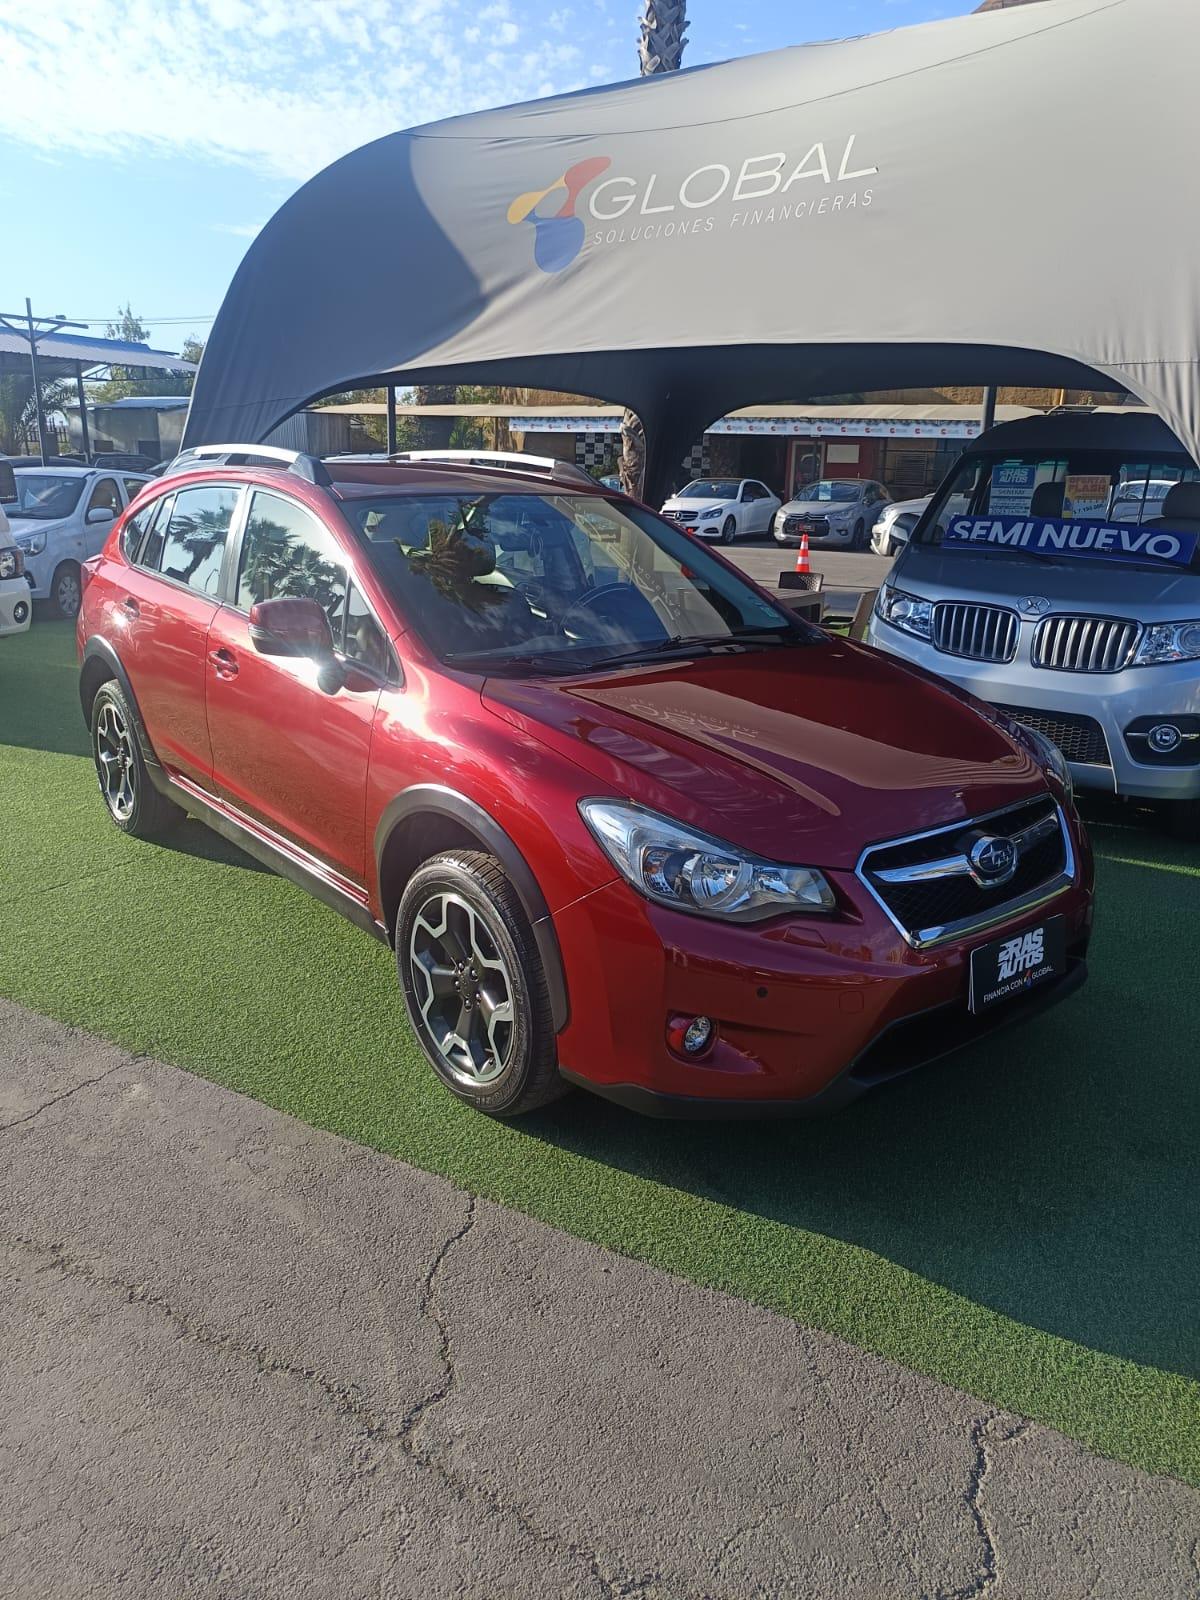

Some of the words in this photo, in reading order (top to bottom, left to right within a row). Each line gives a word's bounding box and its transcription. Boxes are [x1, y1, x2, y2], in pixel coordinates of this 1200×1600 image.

[589, 134, 879, 221] GLOBAL
[592, 216, 716, 246] SOLUCIONES
[729, 189, 874, 228] FINANCIERAS
[952, 520, 1035, 546] SEMI
[1037, 523, 1181, 558] NUEVO
[998, 946, 1044, 982] AUTOS
[983, 984, 1010, 1004] FINANCIA
[1010, 977, 1023, 990] CON
[1031, 965, 1055, 980] GLOBAL
